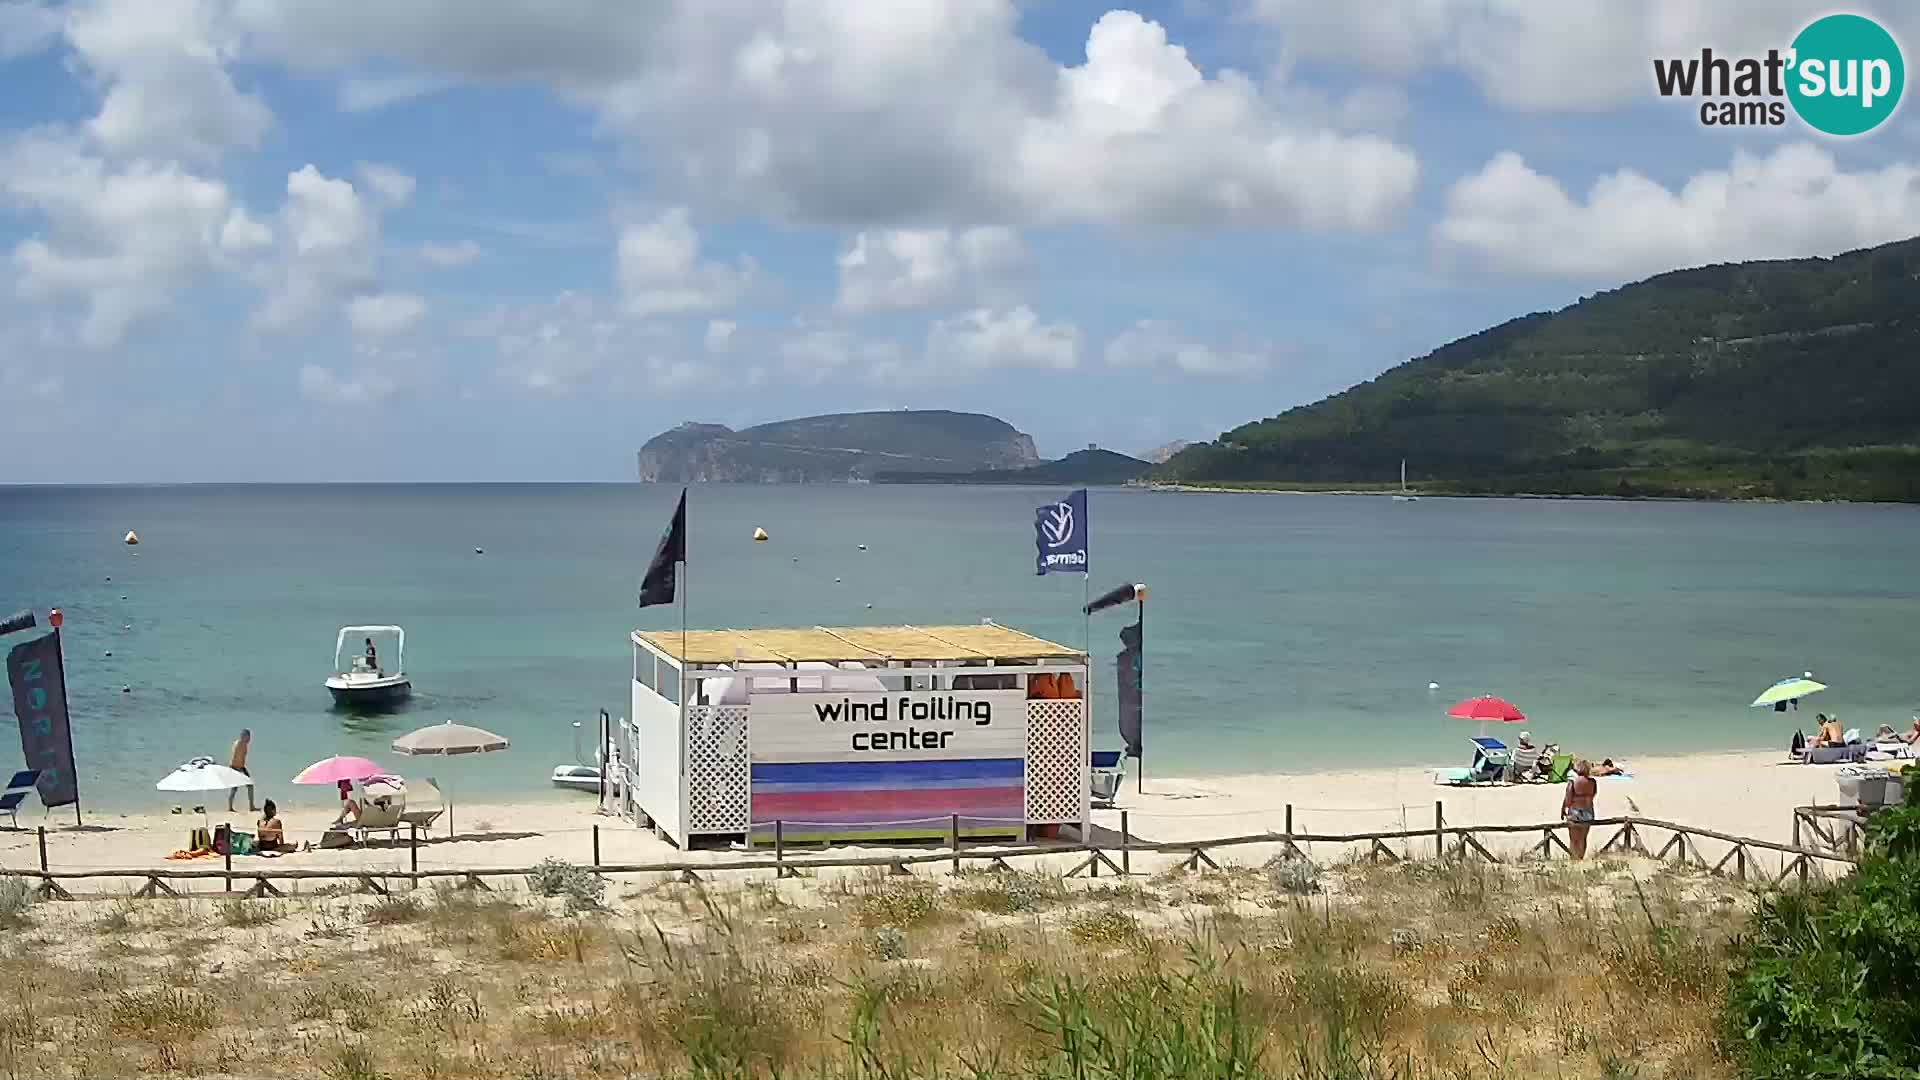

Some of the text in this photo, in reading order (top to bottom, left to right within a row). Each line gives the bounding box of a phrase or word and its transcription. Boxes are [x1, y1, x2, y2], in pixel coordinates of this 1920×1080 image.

[814, 696, 992, 726] wind foiling
[852, 727, 954, 750] center
